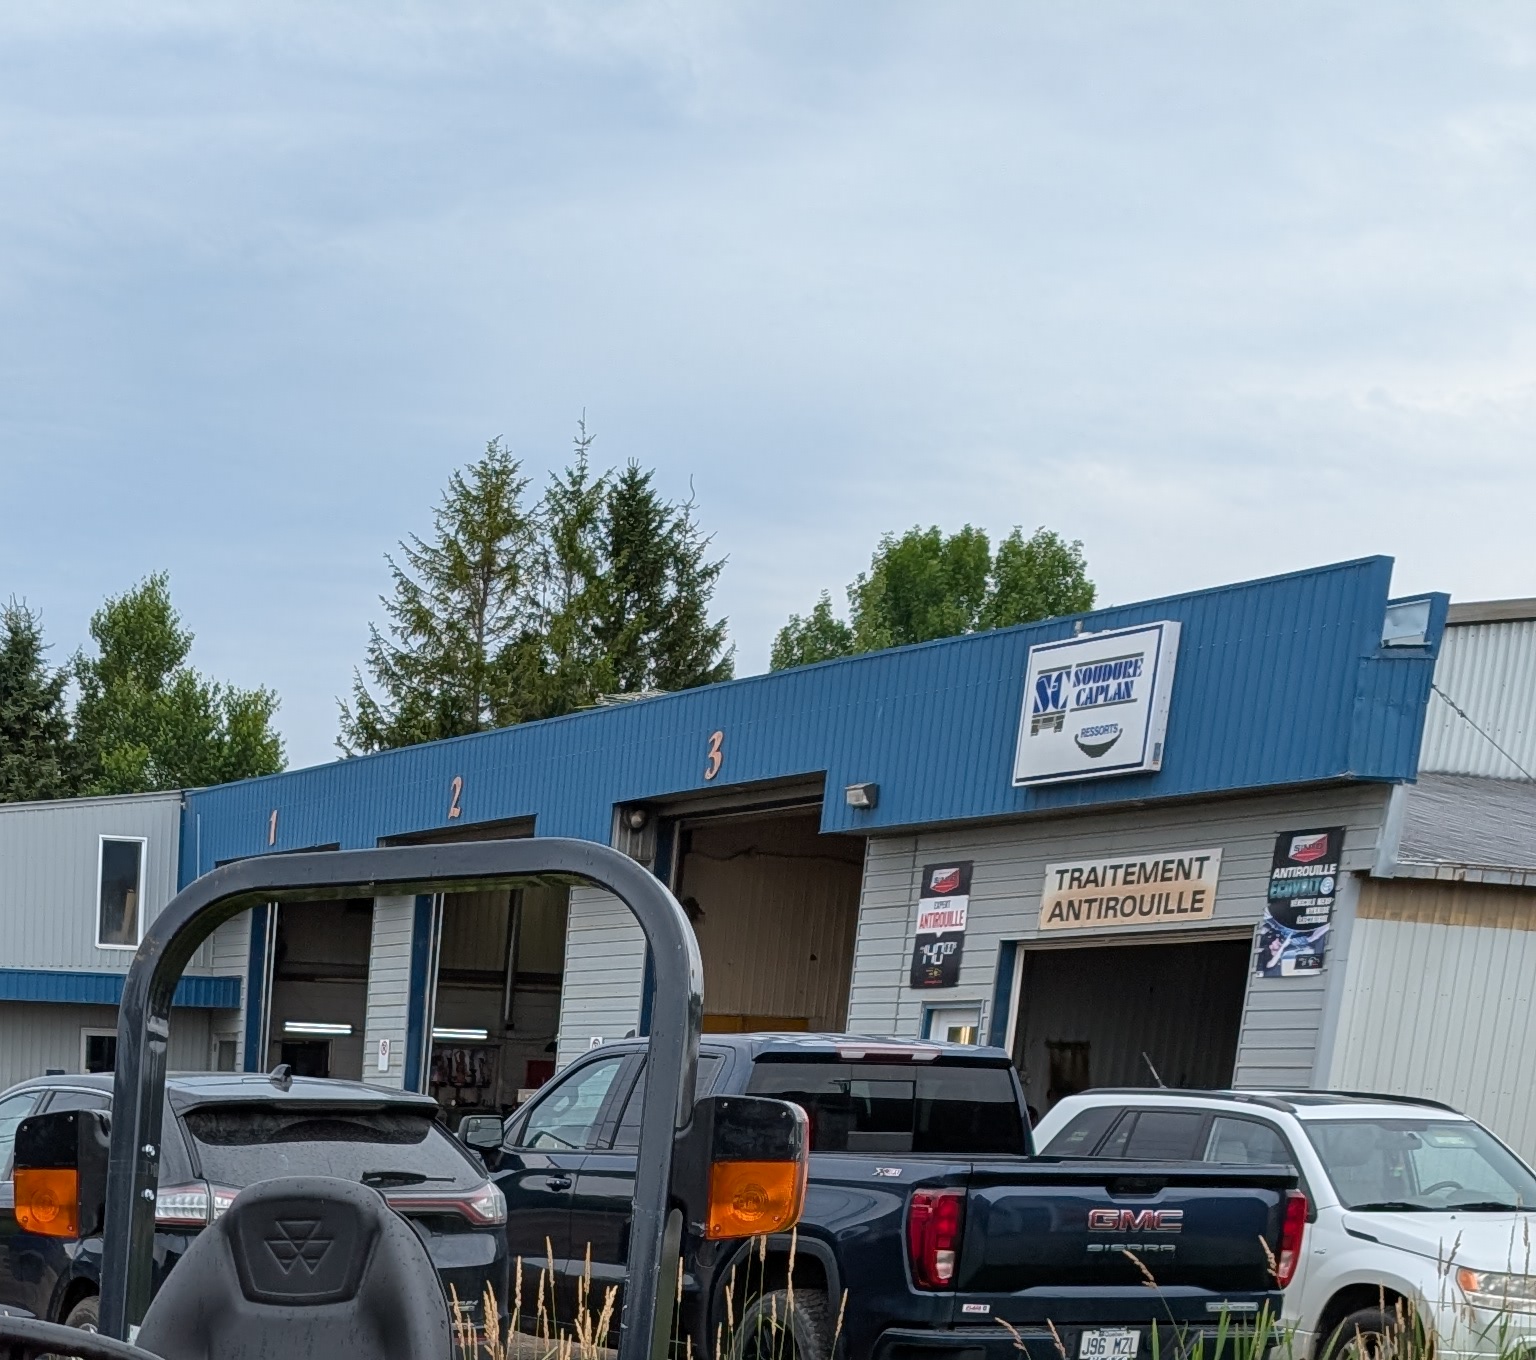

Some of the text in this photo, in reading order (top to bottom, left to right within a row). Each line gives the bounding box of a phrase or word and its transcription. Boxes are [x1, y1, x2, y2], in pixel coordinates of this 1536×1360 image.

[1073, 658, 1144, 688] SOUDURE
[1076, 680, 1134, 707] CAPLAN
[1080, 723, 1119, 738] RESSORTS
[705, 731, 724, 780] 3
[448, 776, 462, 820] 2
[268, 809, 278, 846] 1
[1055, 856, 1211, 891] TRAITEMENT
[1272, 863, 1337, 880] ANTIROUILLE
[919, 909, 965, 929] ANTIROUILLE
[1047, 889, 1206, 923] ANTIROUILLE
[1088, 1209, 1183, 1232] GMC
[1087, 1244, 1176, 1252] SIERRA
[1082, 1336, 1136, 1355] J96 MZL
